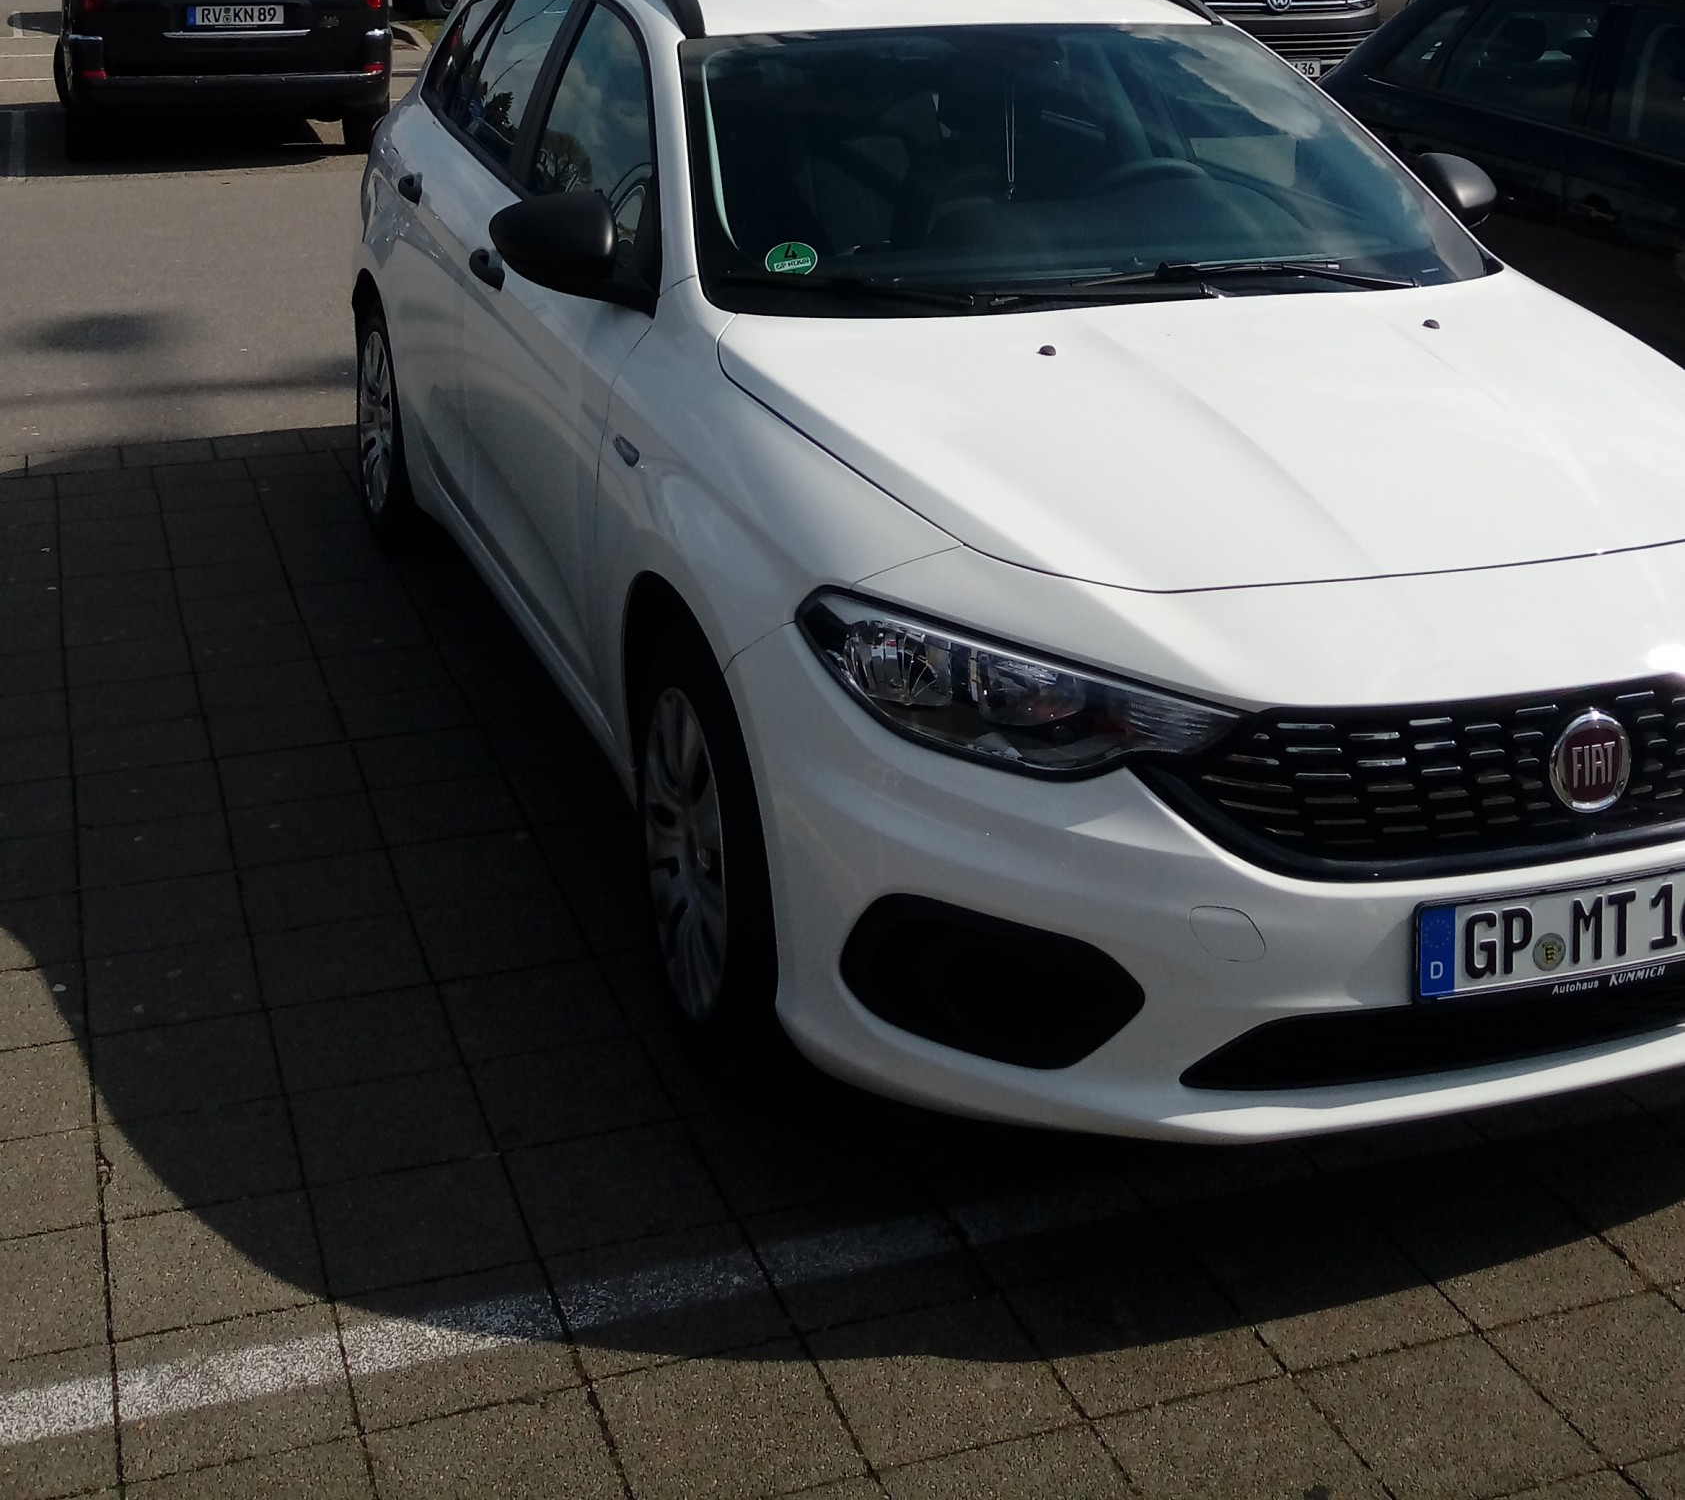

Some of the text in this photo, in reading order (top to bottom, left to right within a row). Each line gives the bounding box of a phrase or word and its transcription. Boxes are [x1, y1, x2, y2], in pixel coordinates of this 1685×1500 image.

[201, 7, 277, 23] RV KN 89
[784, 244, 797, 259] 4
[1571, 741, 1616, 788] FIAT
[1464, 882, 1685, 979] GP MT 1
[1430, 961, 1444, 980] D
[1551, 979, 1600, 995] Autohaus
